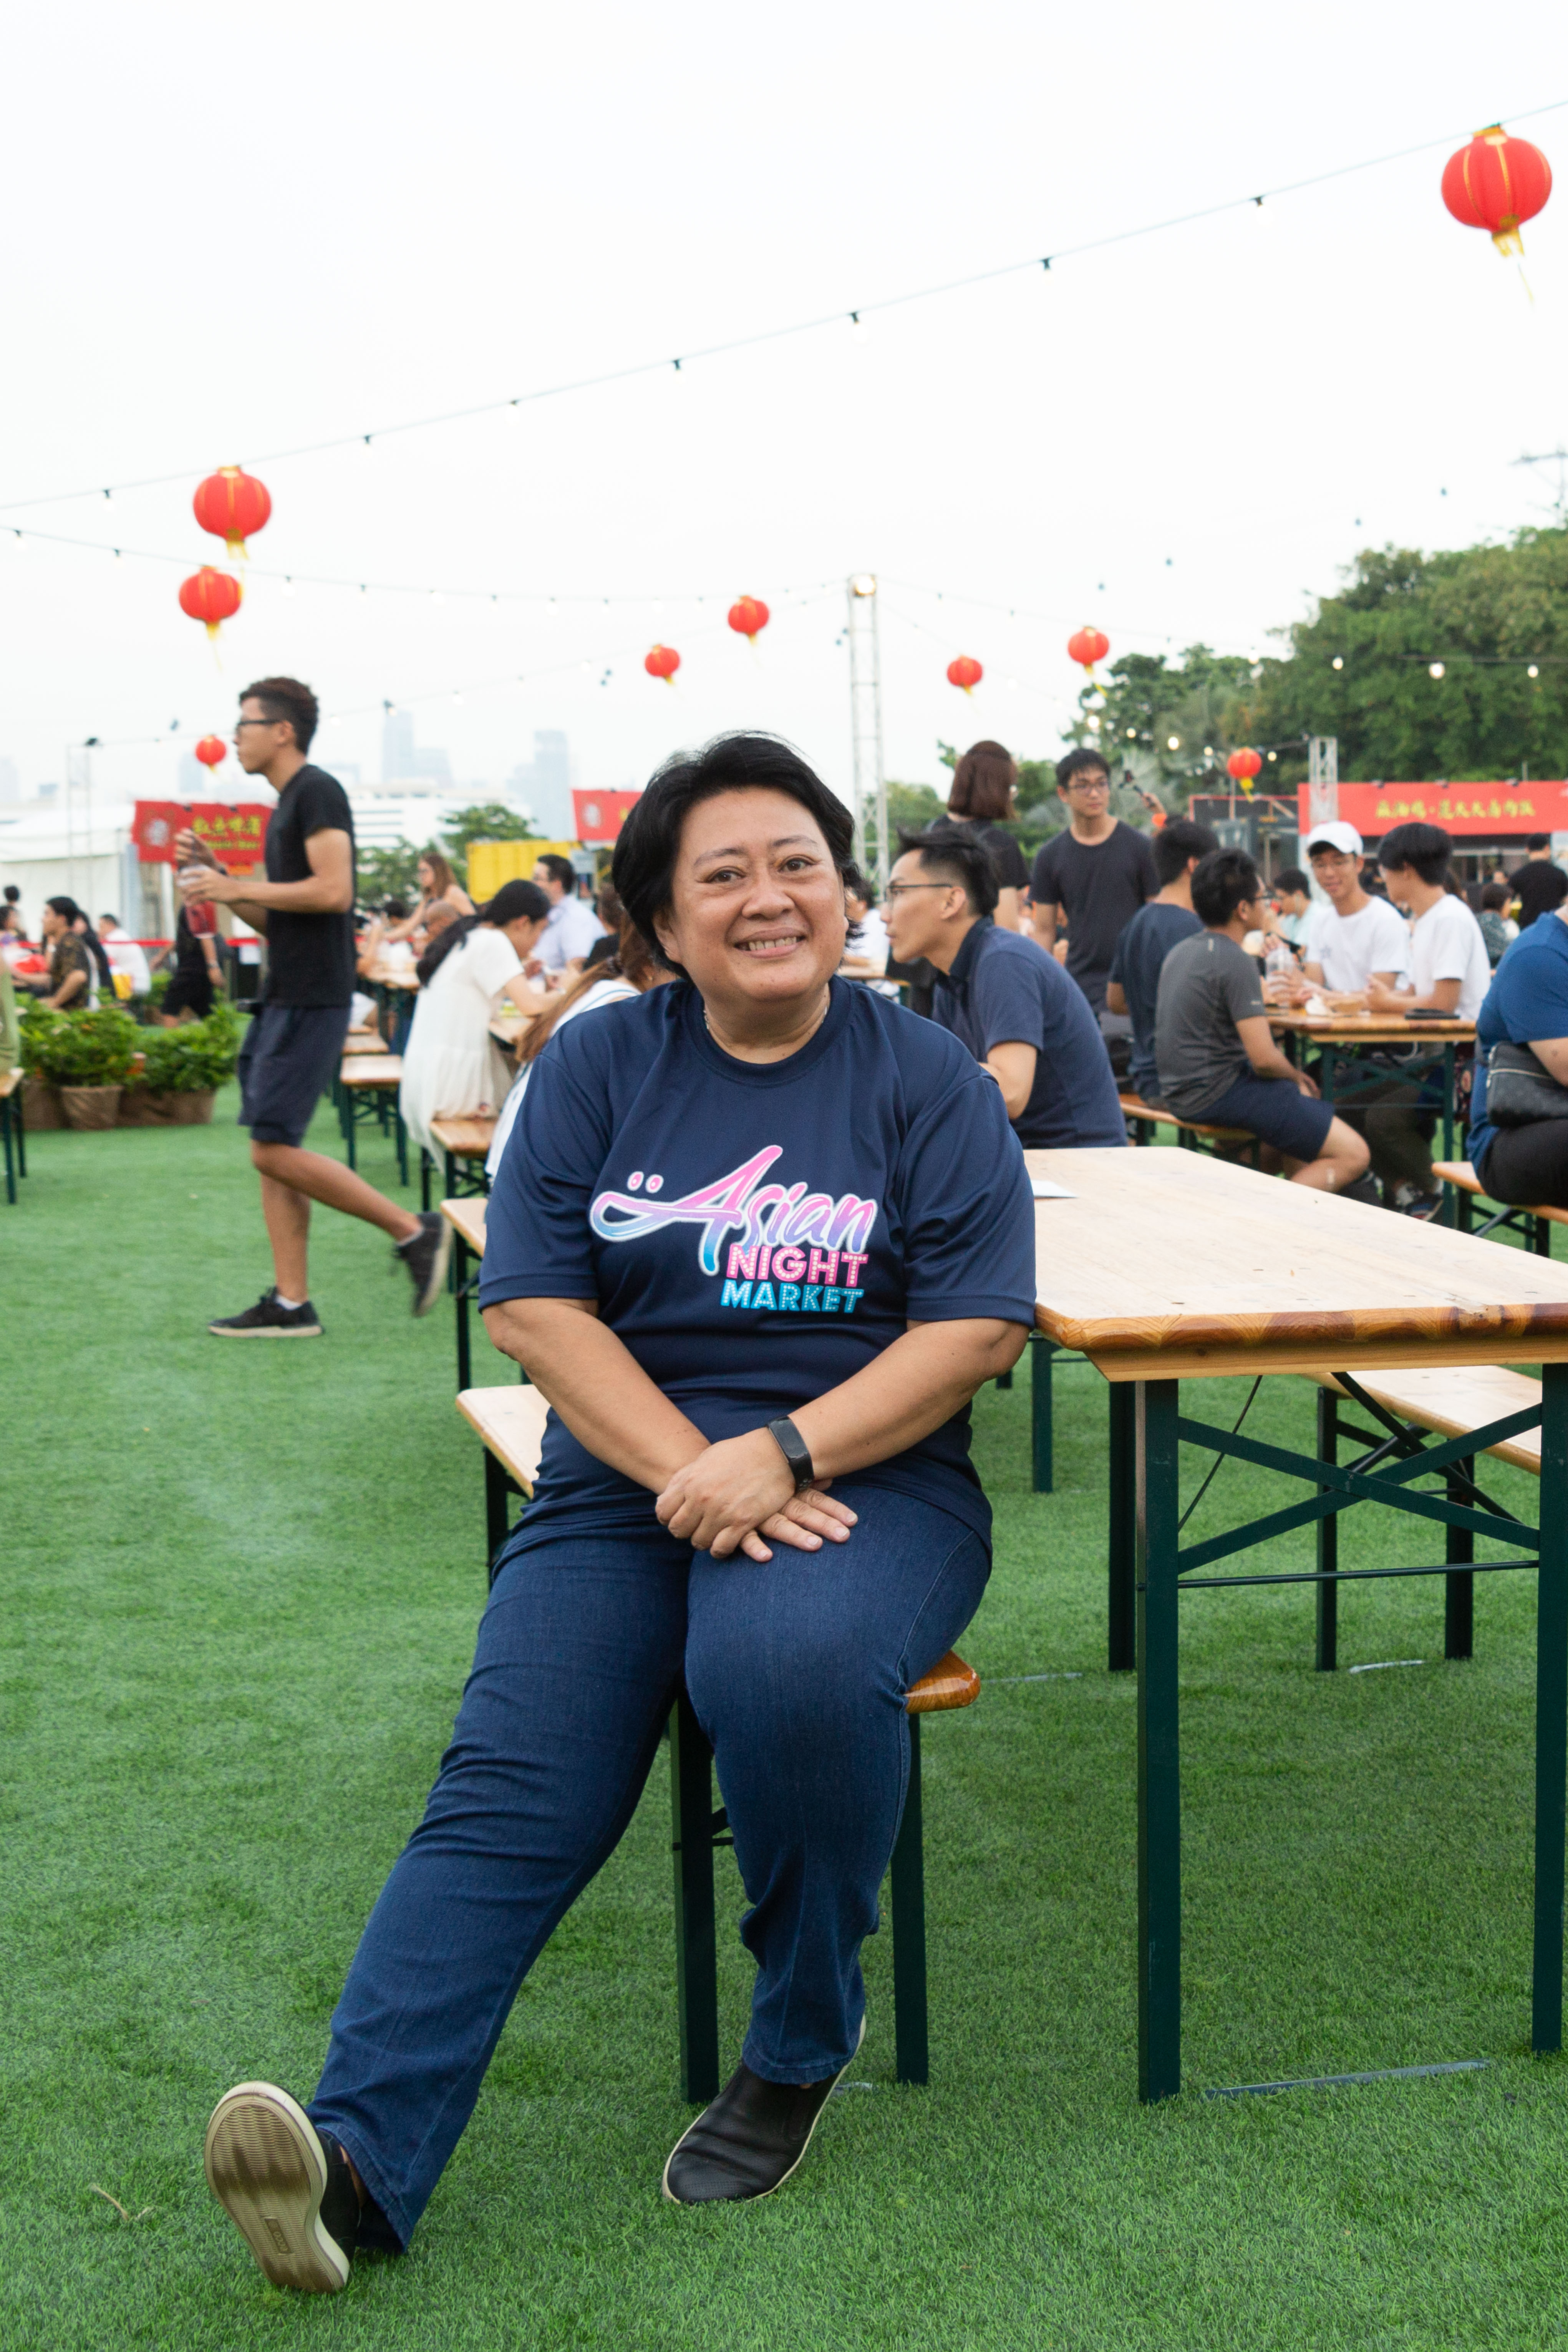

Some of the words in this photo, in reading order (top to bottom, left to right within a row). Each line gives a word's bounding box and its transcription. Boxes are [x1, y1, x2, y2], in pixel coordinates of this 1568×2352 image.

[590, 1145, 877, 1276] Asian
[727, 1244, 869, 1287] NIGHT
[721, 1280, 864, 1313] MARKET
